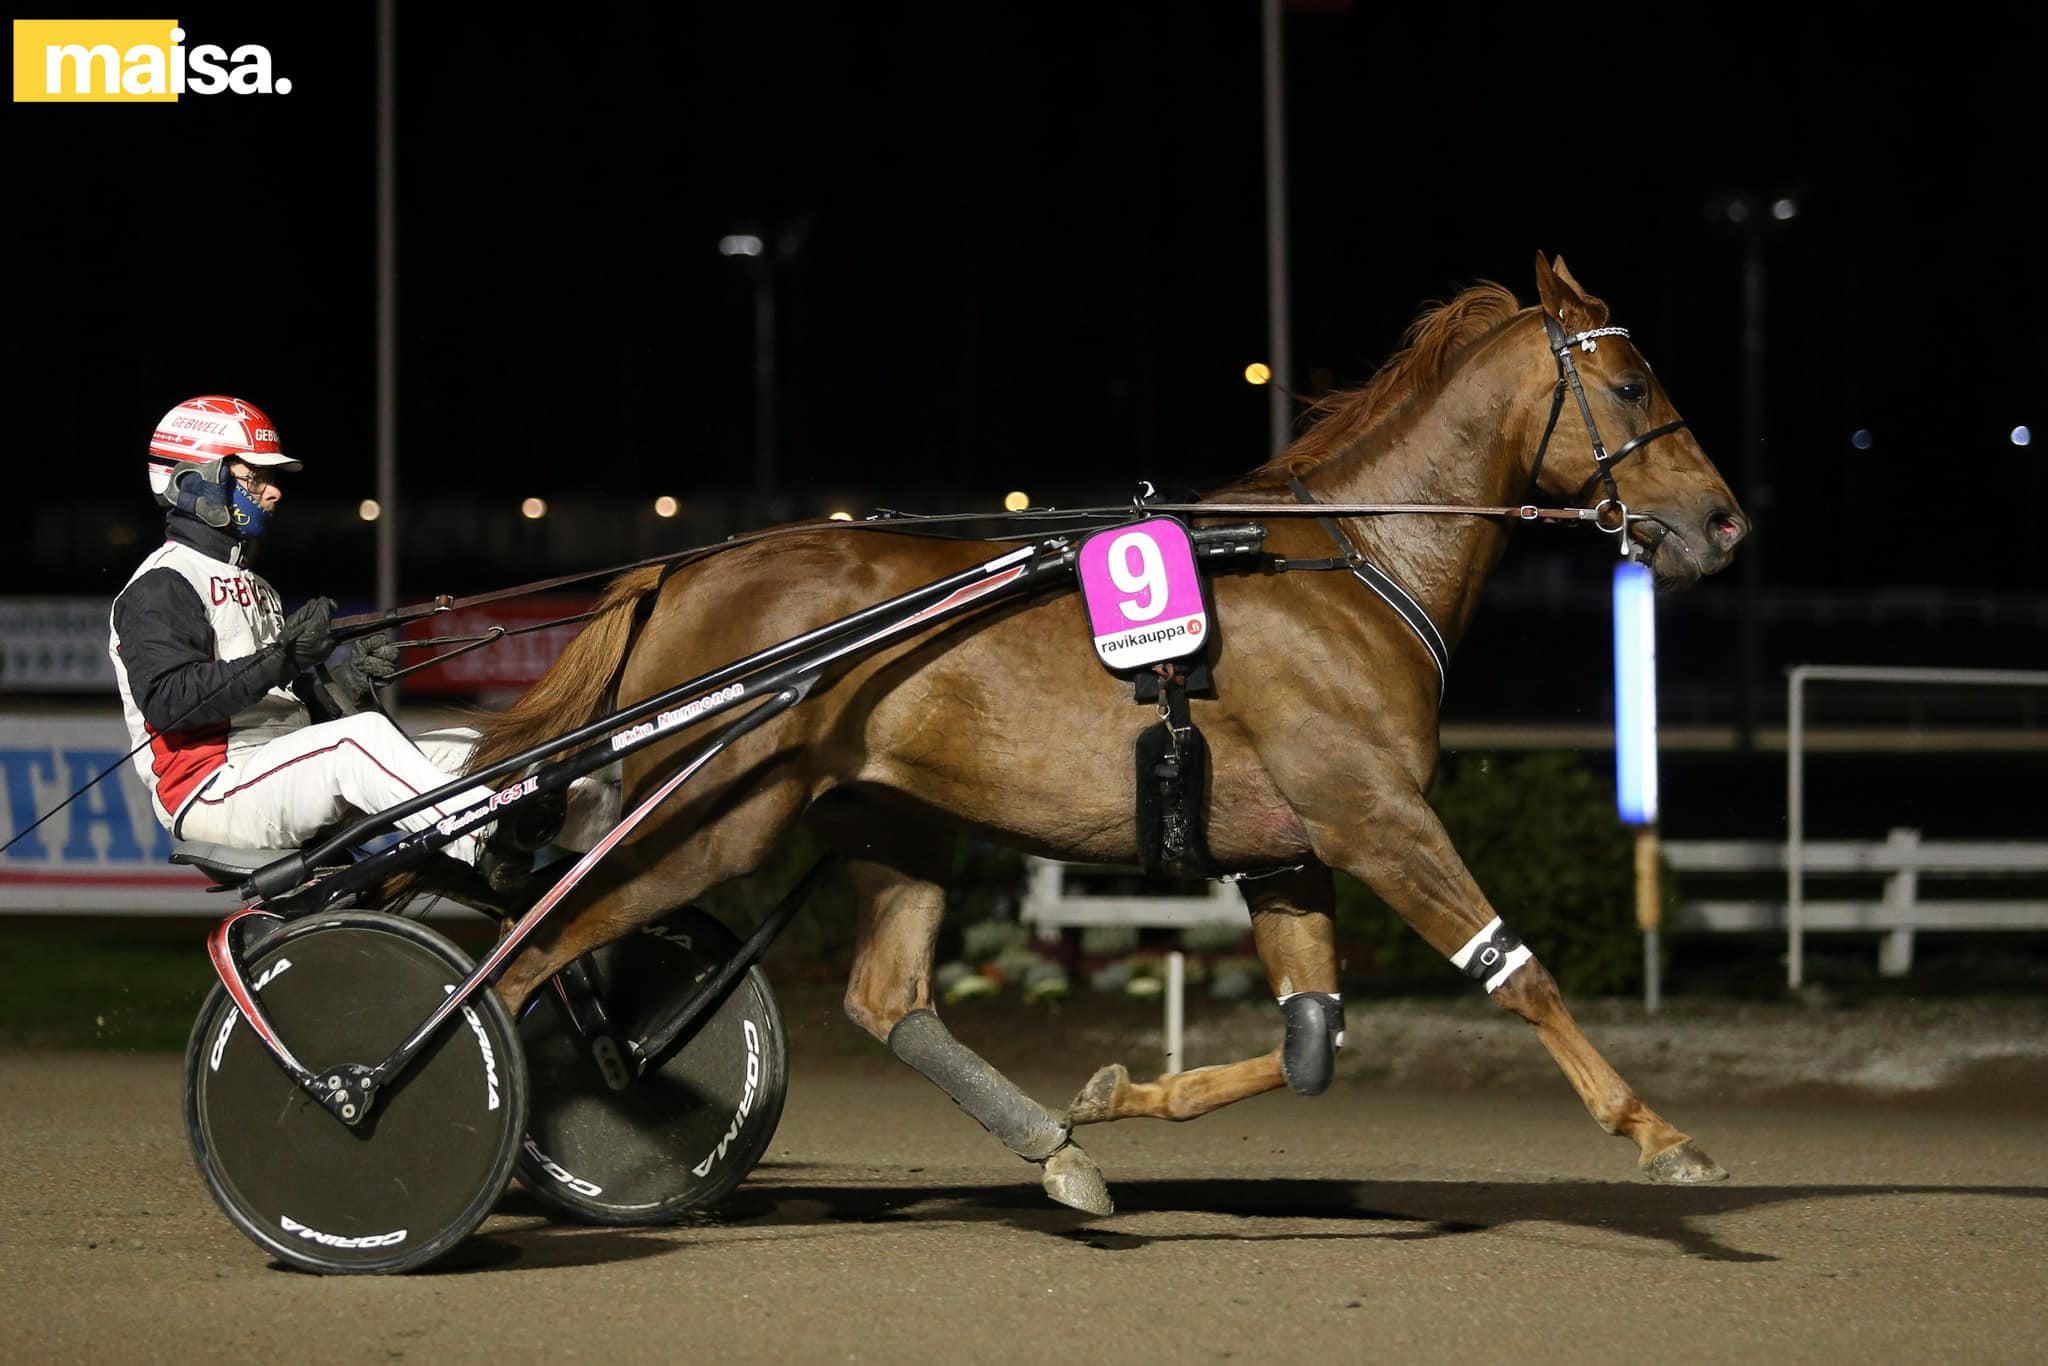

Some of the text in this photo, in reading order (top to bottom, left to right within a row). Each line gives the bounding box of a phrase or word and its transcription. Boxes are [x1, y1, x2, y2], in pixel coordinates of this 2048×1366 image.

[171, 416, 229, 436] GEBWELL
[1108, 532, 1168, 621] 9
[612, 683, 744, 751] Ilkka Nurmonen
[0, 751, 160, 860] TA
[489, 783, 522, 812] FCS
[692, 1020, 760, 1177] CORIMA
[523, 1133, 603, 1197] COR
[281, 1215, 407, 1248] CORIMA
